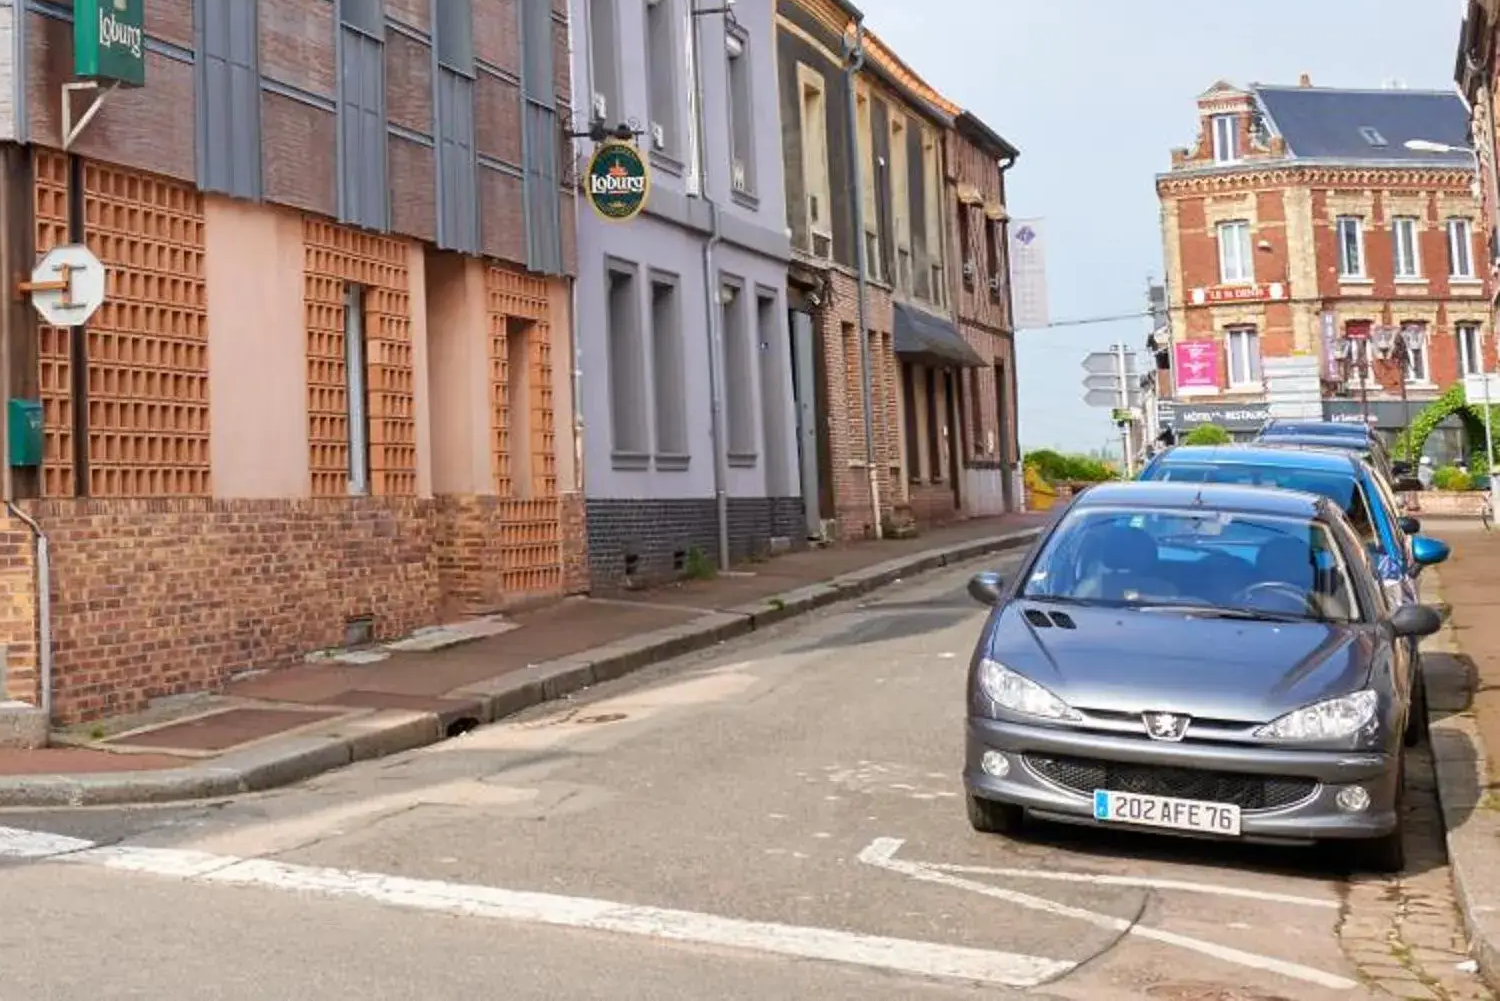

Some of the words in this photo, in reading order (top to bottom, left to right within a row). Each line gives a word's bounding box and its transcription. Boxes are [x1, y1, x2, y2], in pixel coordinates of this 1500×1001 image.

[99, 6, 141, 59] Loburg
[591, 174, 644, 194] Loburg
[1115, 796, 1155, 820] 202
[1160, 802, 1200, 826] AFE
[1205, 806, 1232, 830] 76
